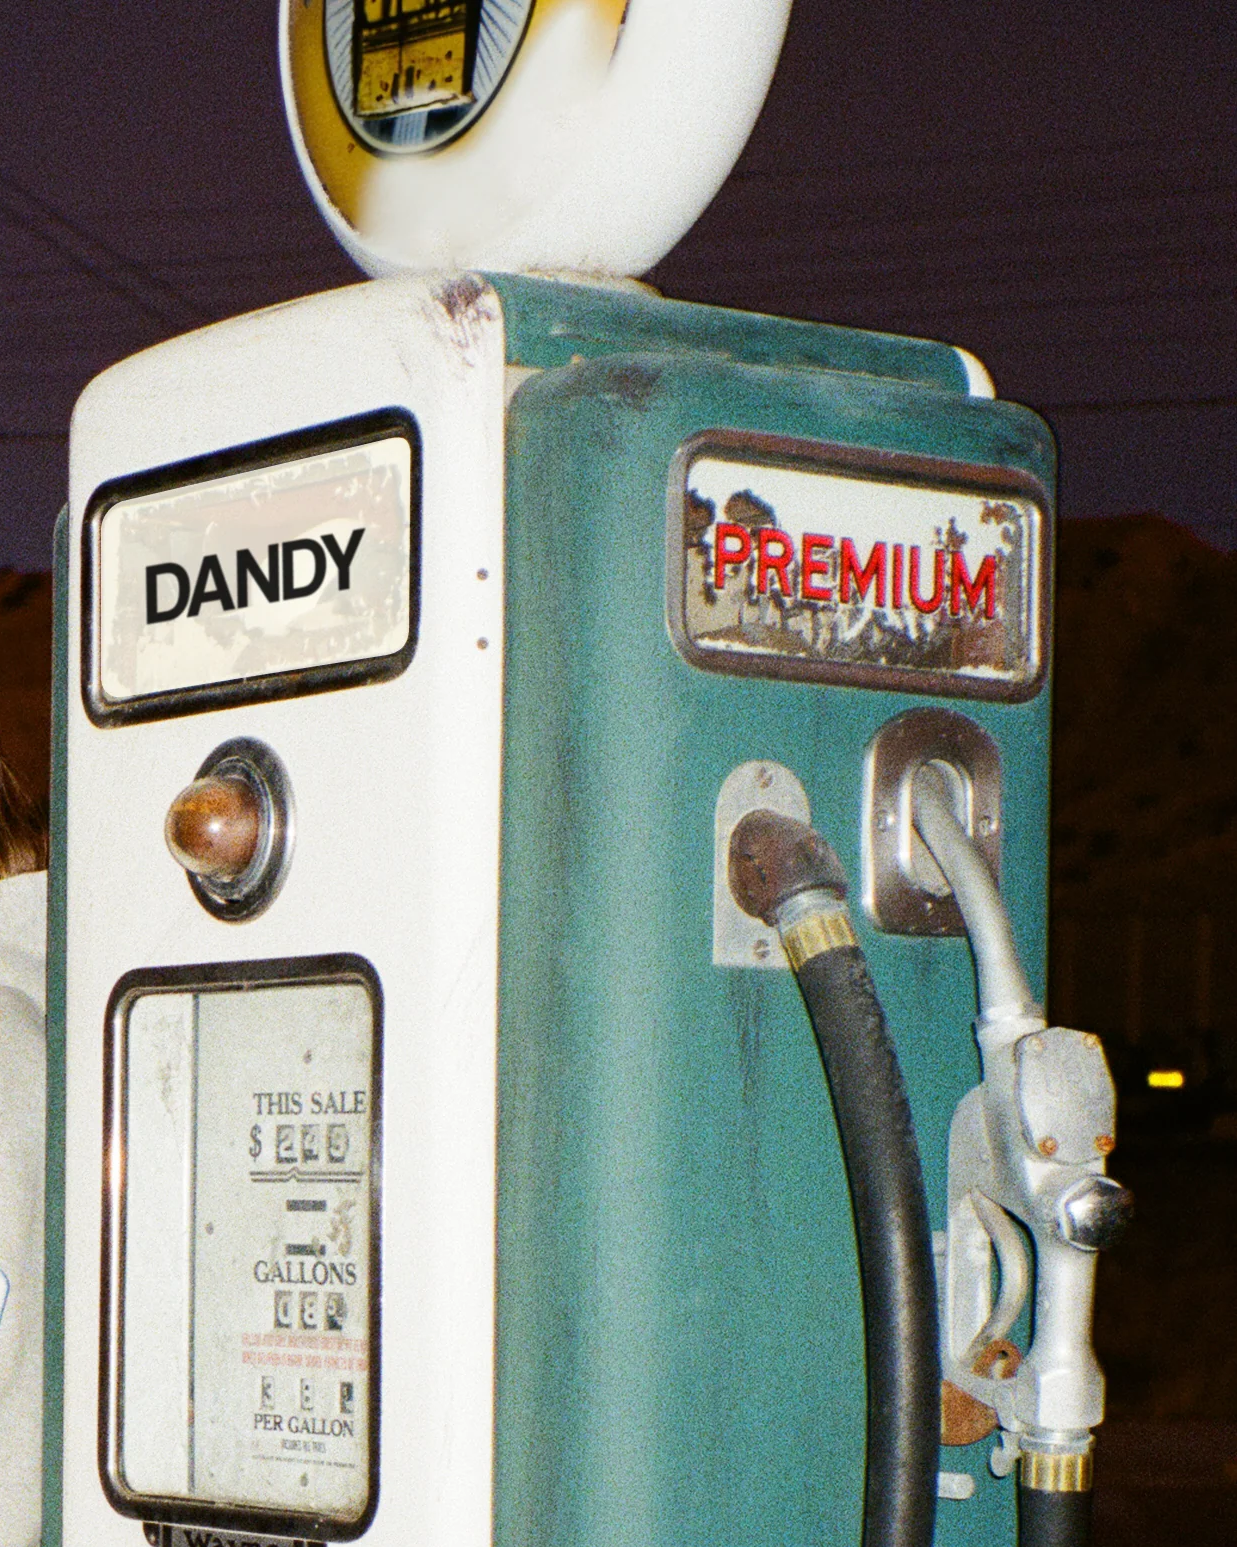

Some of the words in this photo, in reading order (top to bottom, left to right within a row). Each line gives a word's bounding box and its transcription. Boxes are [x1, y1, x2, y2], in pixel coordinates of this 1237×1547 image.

[145, 527, 366, 625] DANDY
[714, 522, 999, 619] PREMIUM
[253, 1091, 303, 1115] THIS
[311, 1090, 366, 1114] SALE
[253, 1260, 357, 1285] GALLONS
[254, 1413, 283, 1432] PER
[288, 1416, 355, 1438] GALLON
